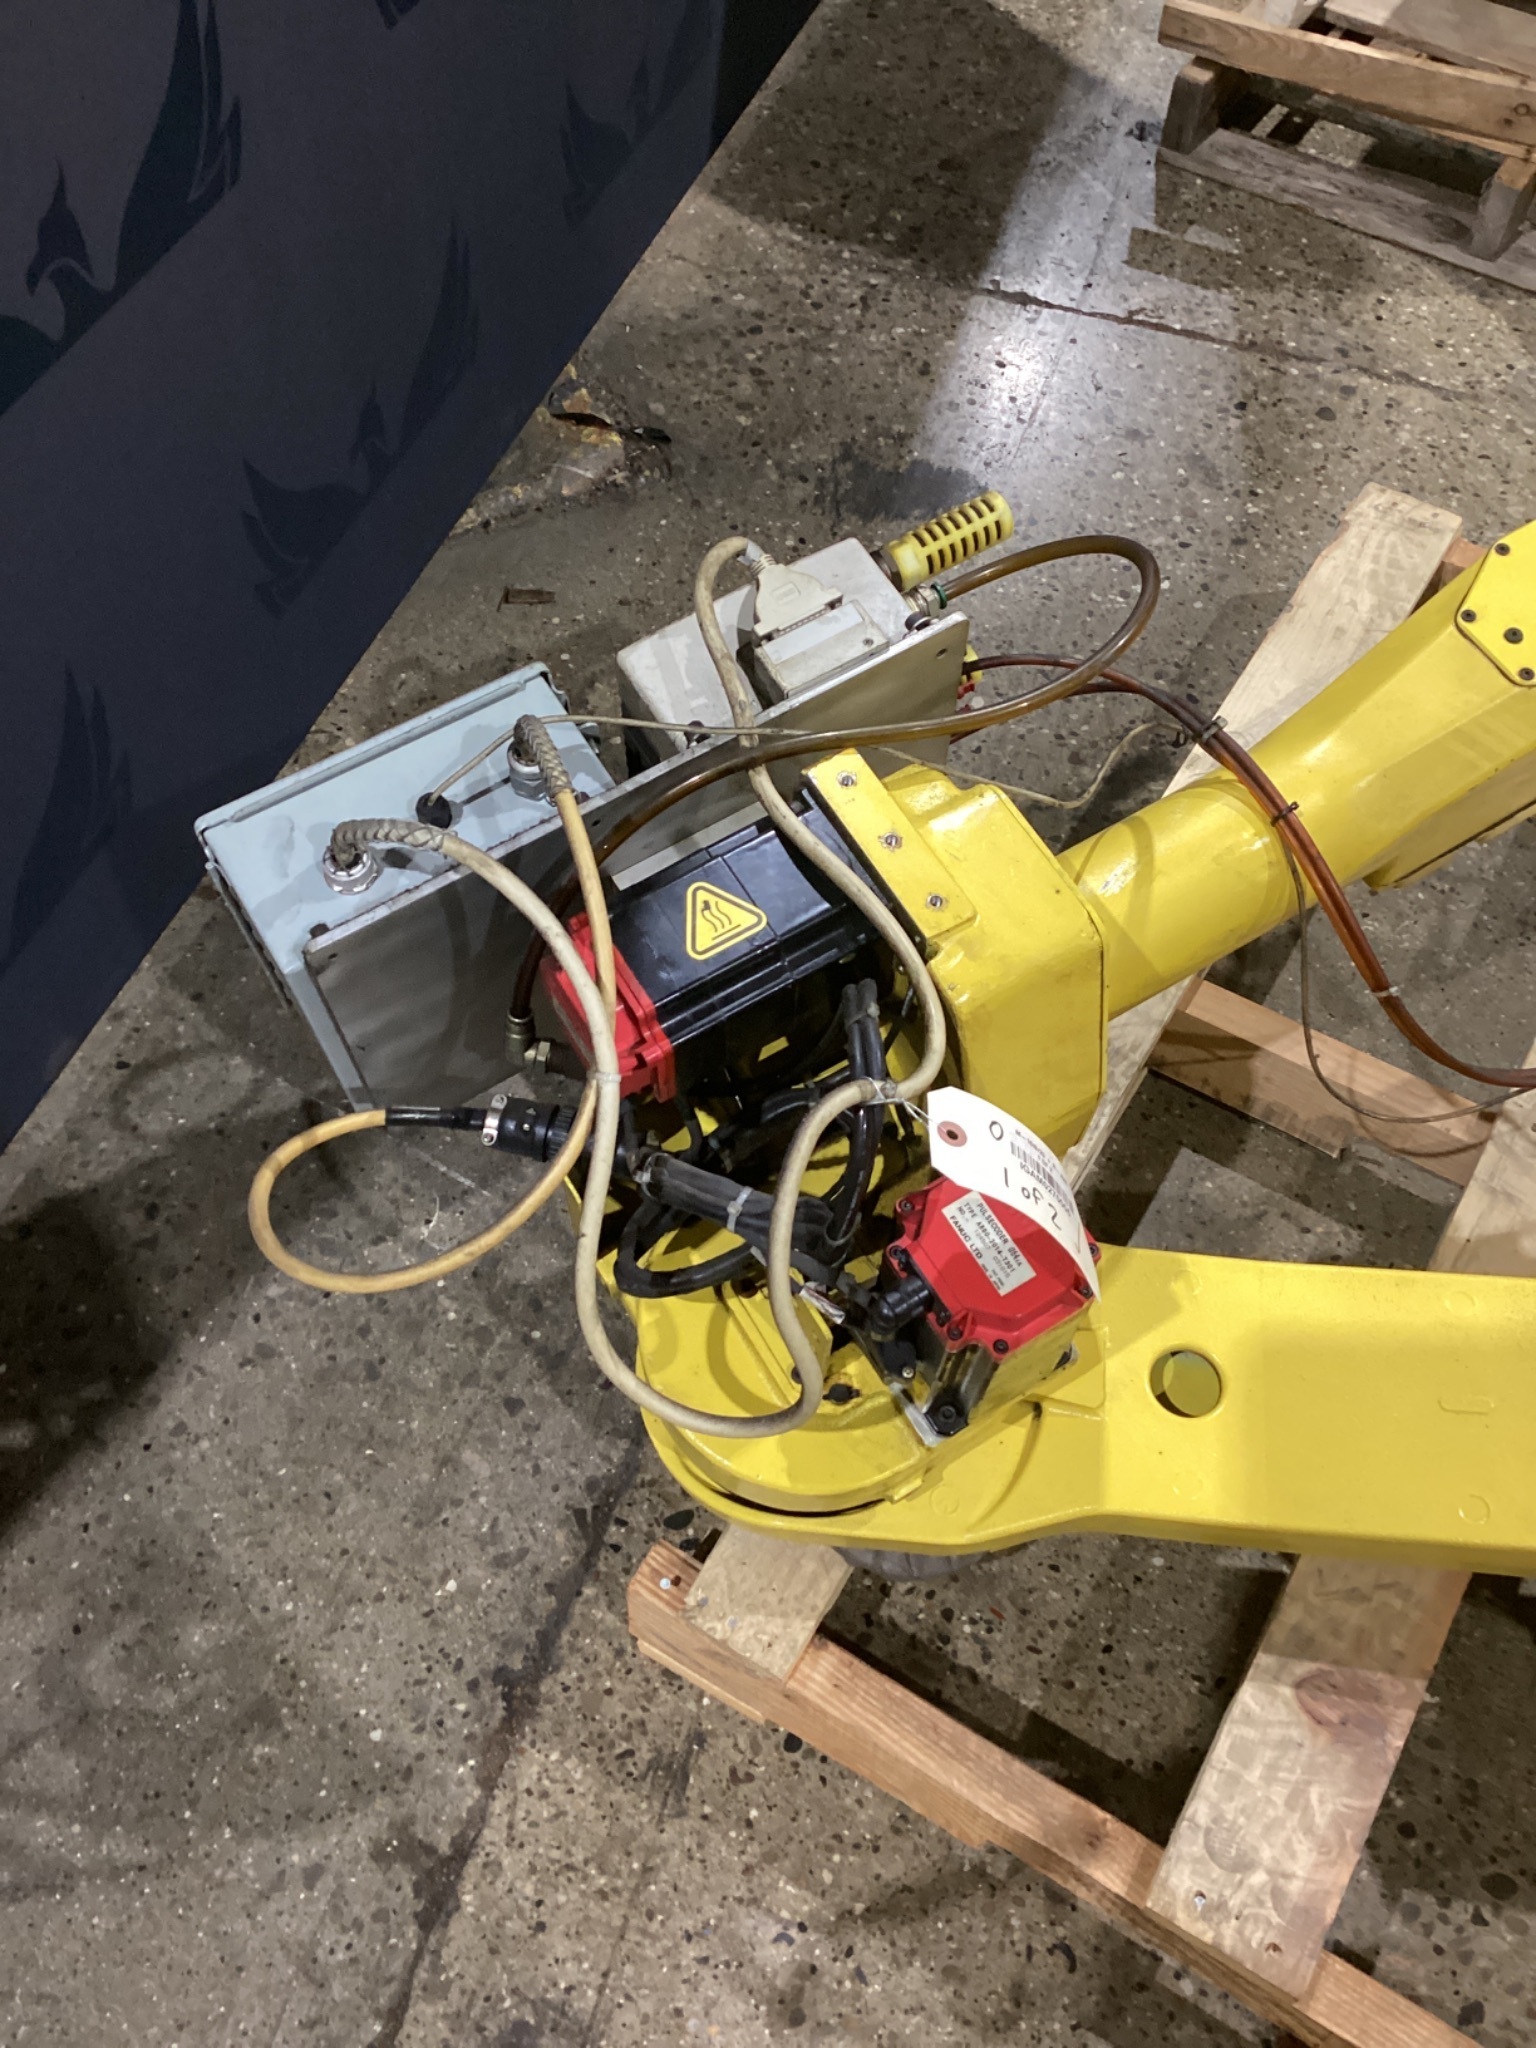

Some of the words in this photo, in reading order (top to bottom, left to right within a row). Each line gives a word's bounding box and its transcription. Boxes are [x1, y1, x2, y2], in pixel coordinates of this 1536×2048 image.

[963, 1202, 978, 1219] TYPE
[1003, 1166, 1010, 1188] 1
[1021, 1186, 1044, 1206] of
[1047, 1201, 1062, 1231] 2
[949, 1215, 971, 1243] FANUC
[969, 1243, 983, 1260] LTD
[976, 1202, 1009, 1245] PULSECODER
